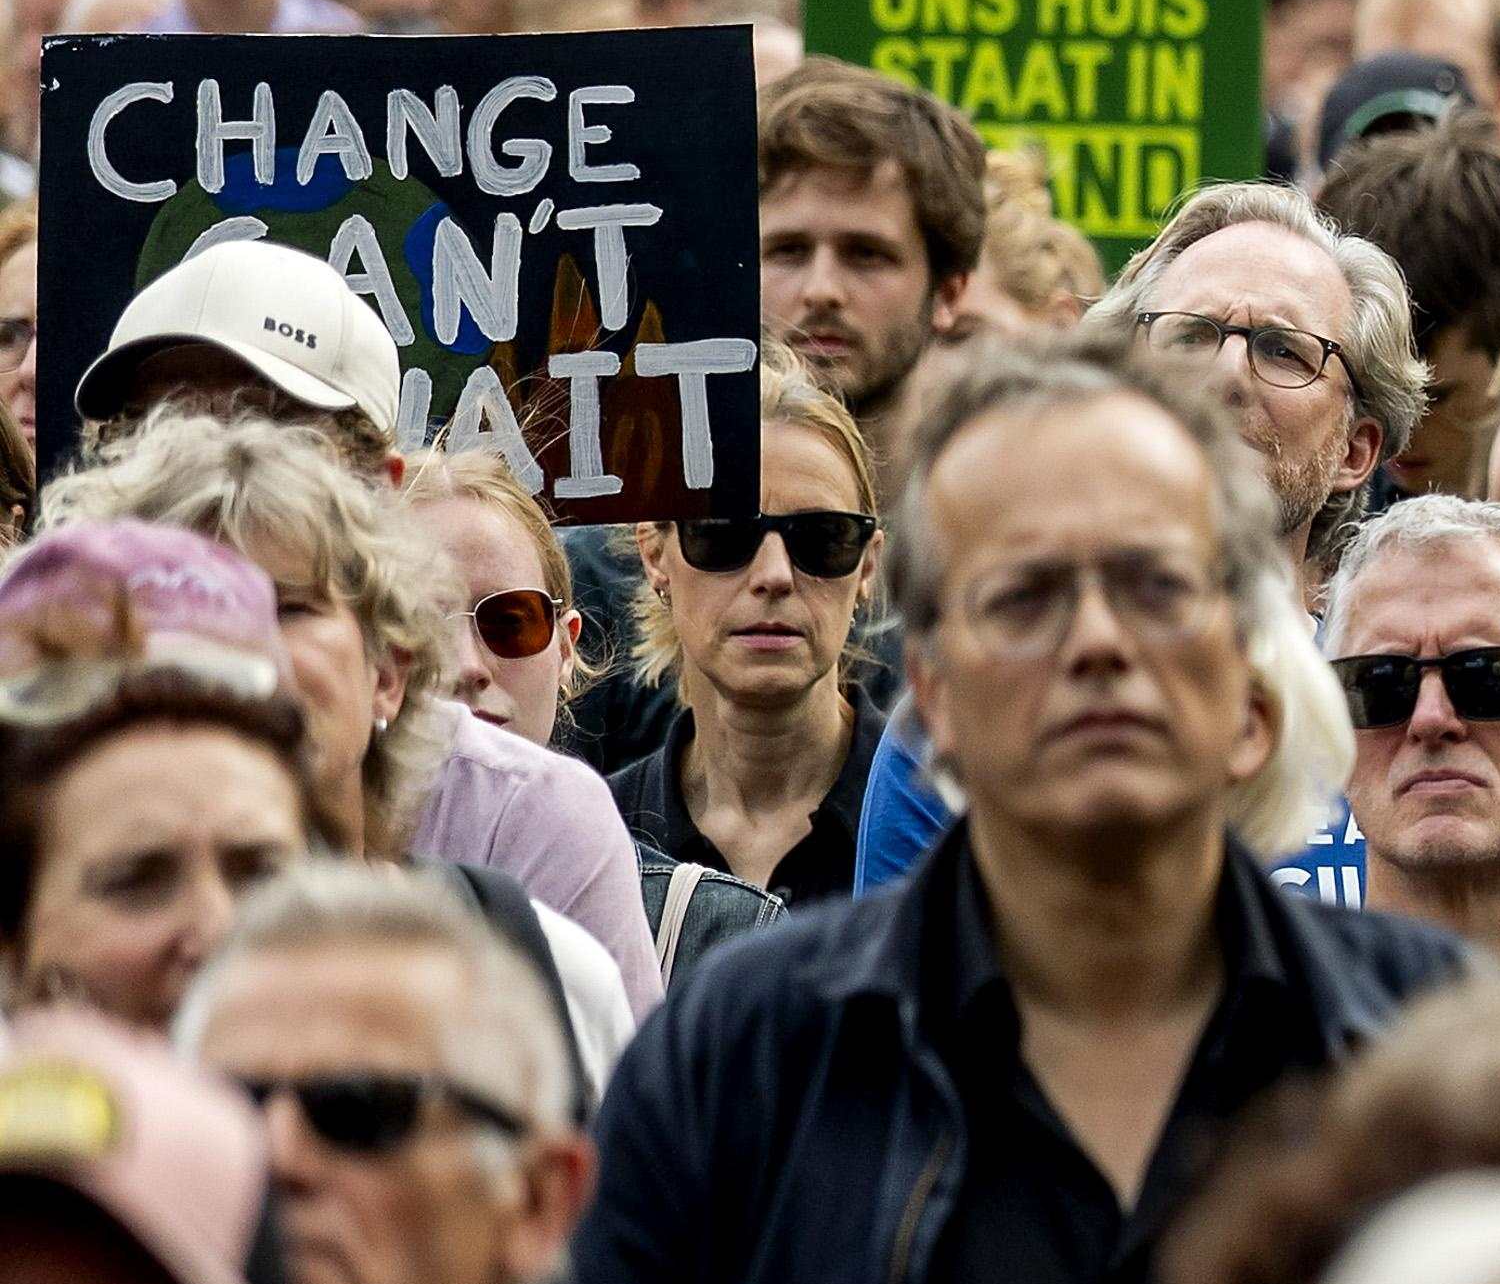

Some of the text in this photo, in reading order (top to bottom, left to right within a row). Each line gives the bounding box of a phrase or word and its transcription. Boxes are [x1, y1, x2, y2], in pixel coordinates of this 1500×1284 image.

[88, 76, 641, 203] CHANGE
[873, 37, 1203, 119] STAAT IN
[183, 199, 663, 347] AN'T
[264, 316, 317, 349] BOSS
[400, 339, 757, 499] AIT
